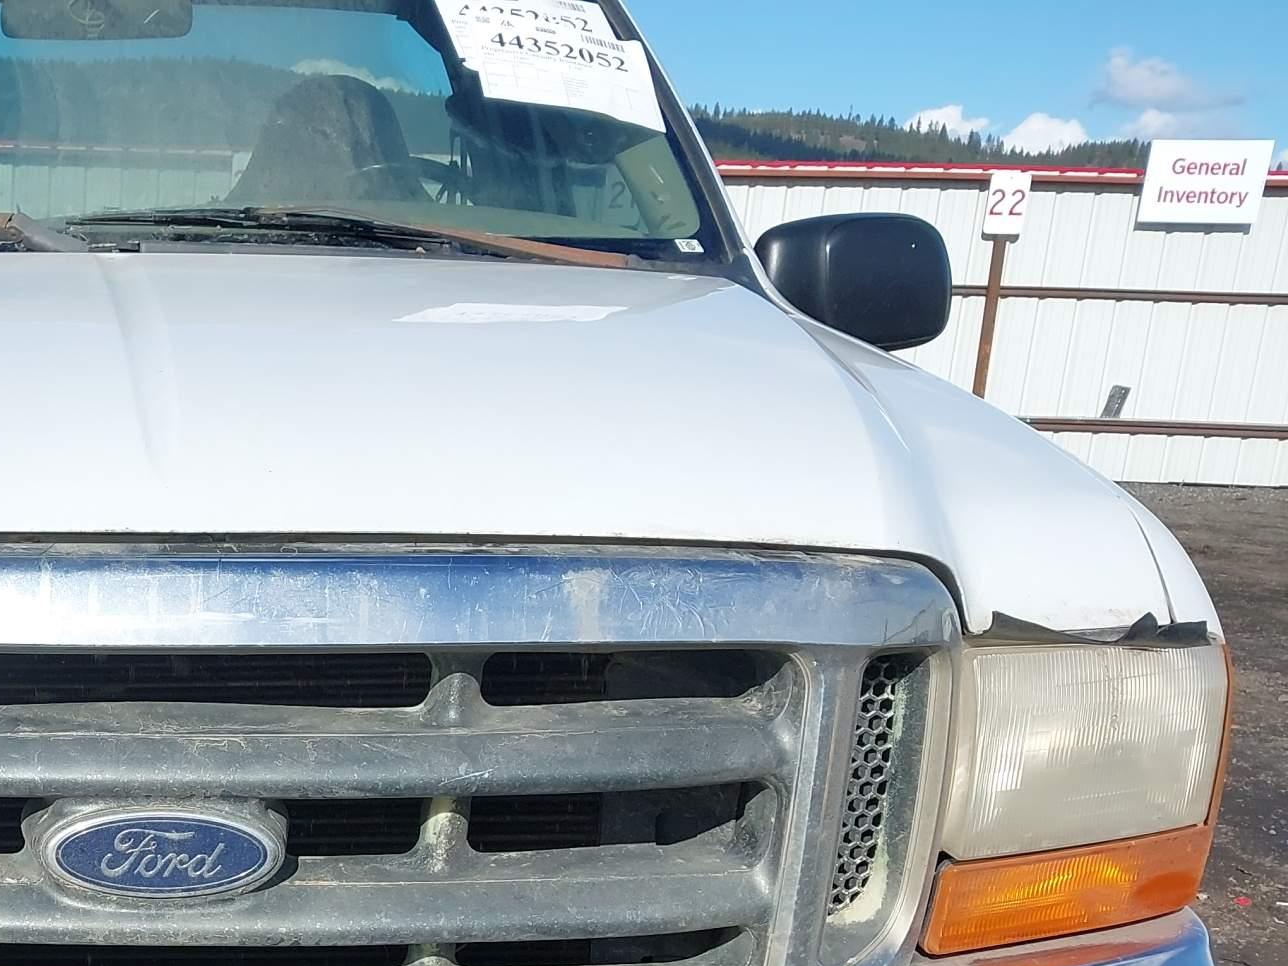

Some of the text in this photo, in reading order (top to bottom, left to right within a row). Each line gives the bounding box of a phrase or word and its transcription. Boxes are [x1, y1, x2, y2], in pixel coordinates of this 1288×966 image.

[490, 32, 629, 73] 44352052
[1171, 157, 1247, 176] General
[988, 188, 1026, 216] 22
[1157, 186, 1249, 208] Inventory
[101, 828, 226, 878] Ford
